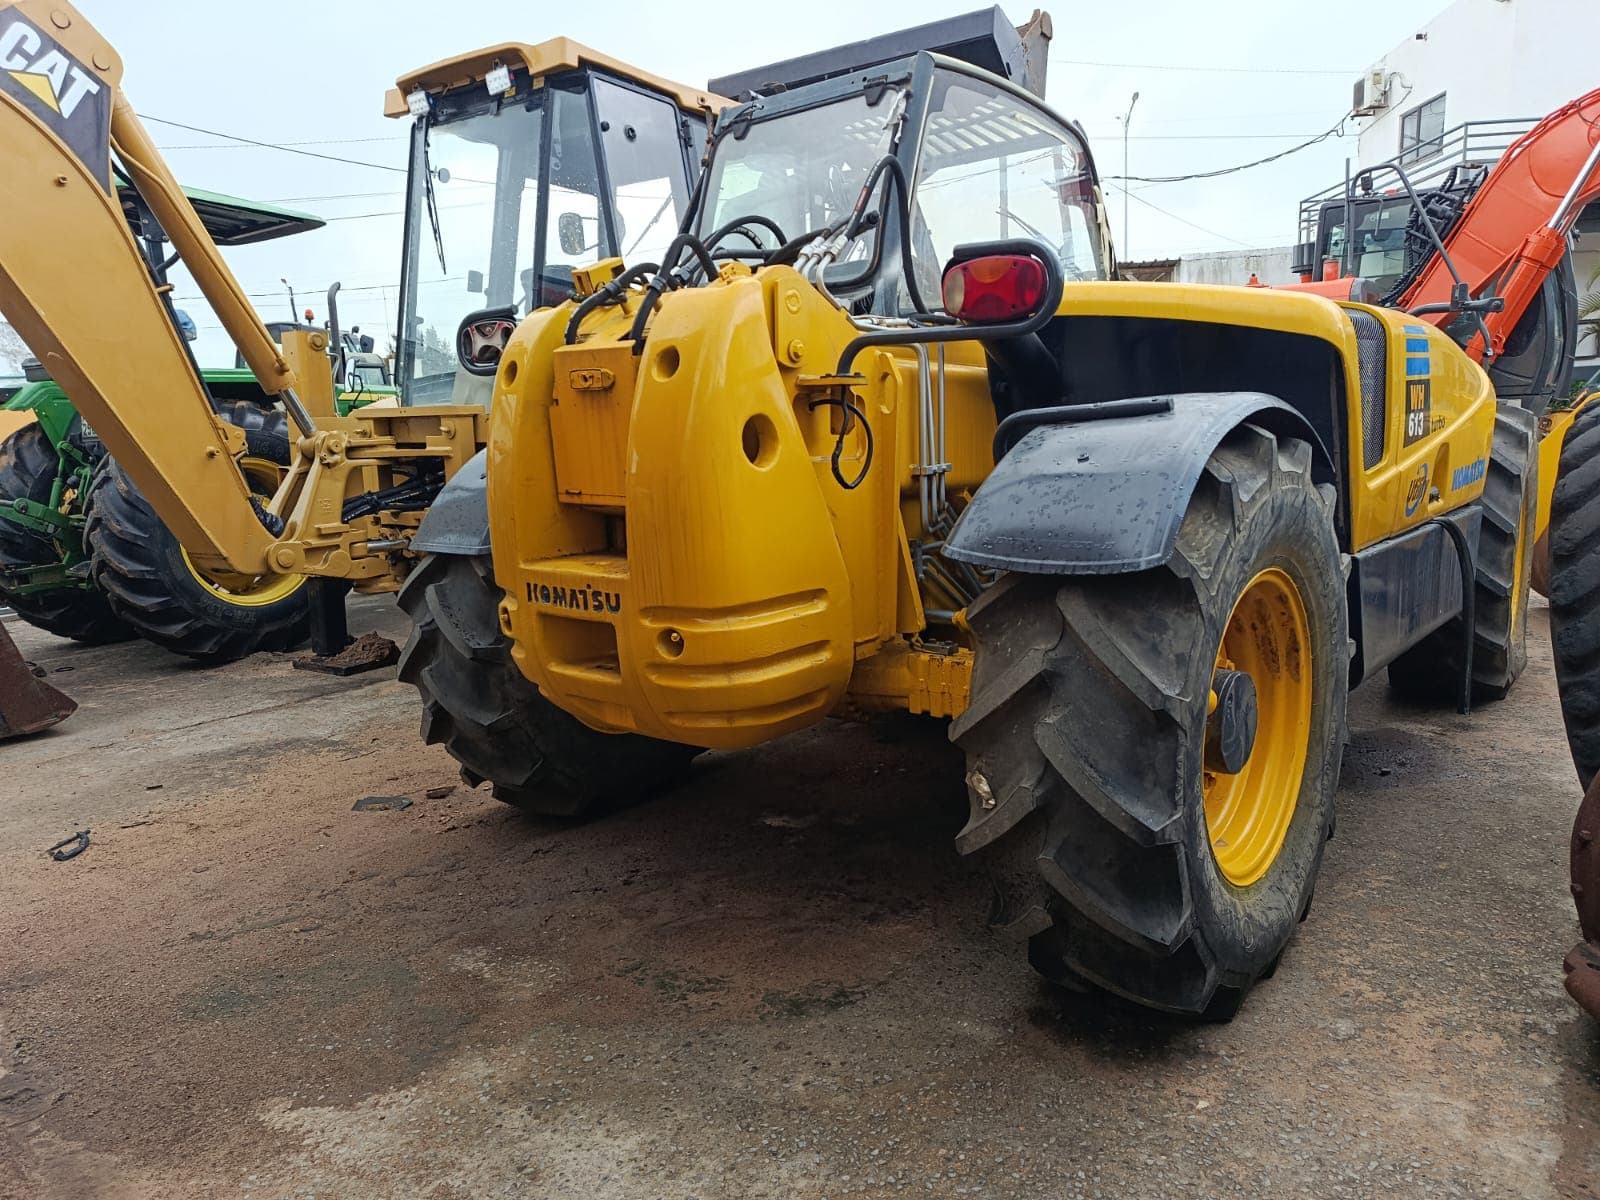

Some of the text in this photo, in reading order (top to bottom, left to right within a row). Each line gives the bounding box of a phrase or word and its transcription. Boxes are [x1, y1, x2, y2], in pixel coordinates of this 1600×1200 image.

[0, 21, 100, 119] CAT
[1410, 384, 1425, 410] WH
[1408, 411, 1424, 437] 613
[1452, 456, 1486, 491] KOMATSU
[526, 582, 621, 613] KOMATSU
